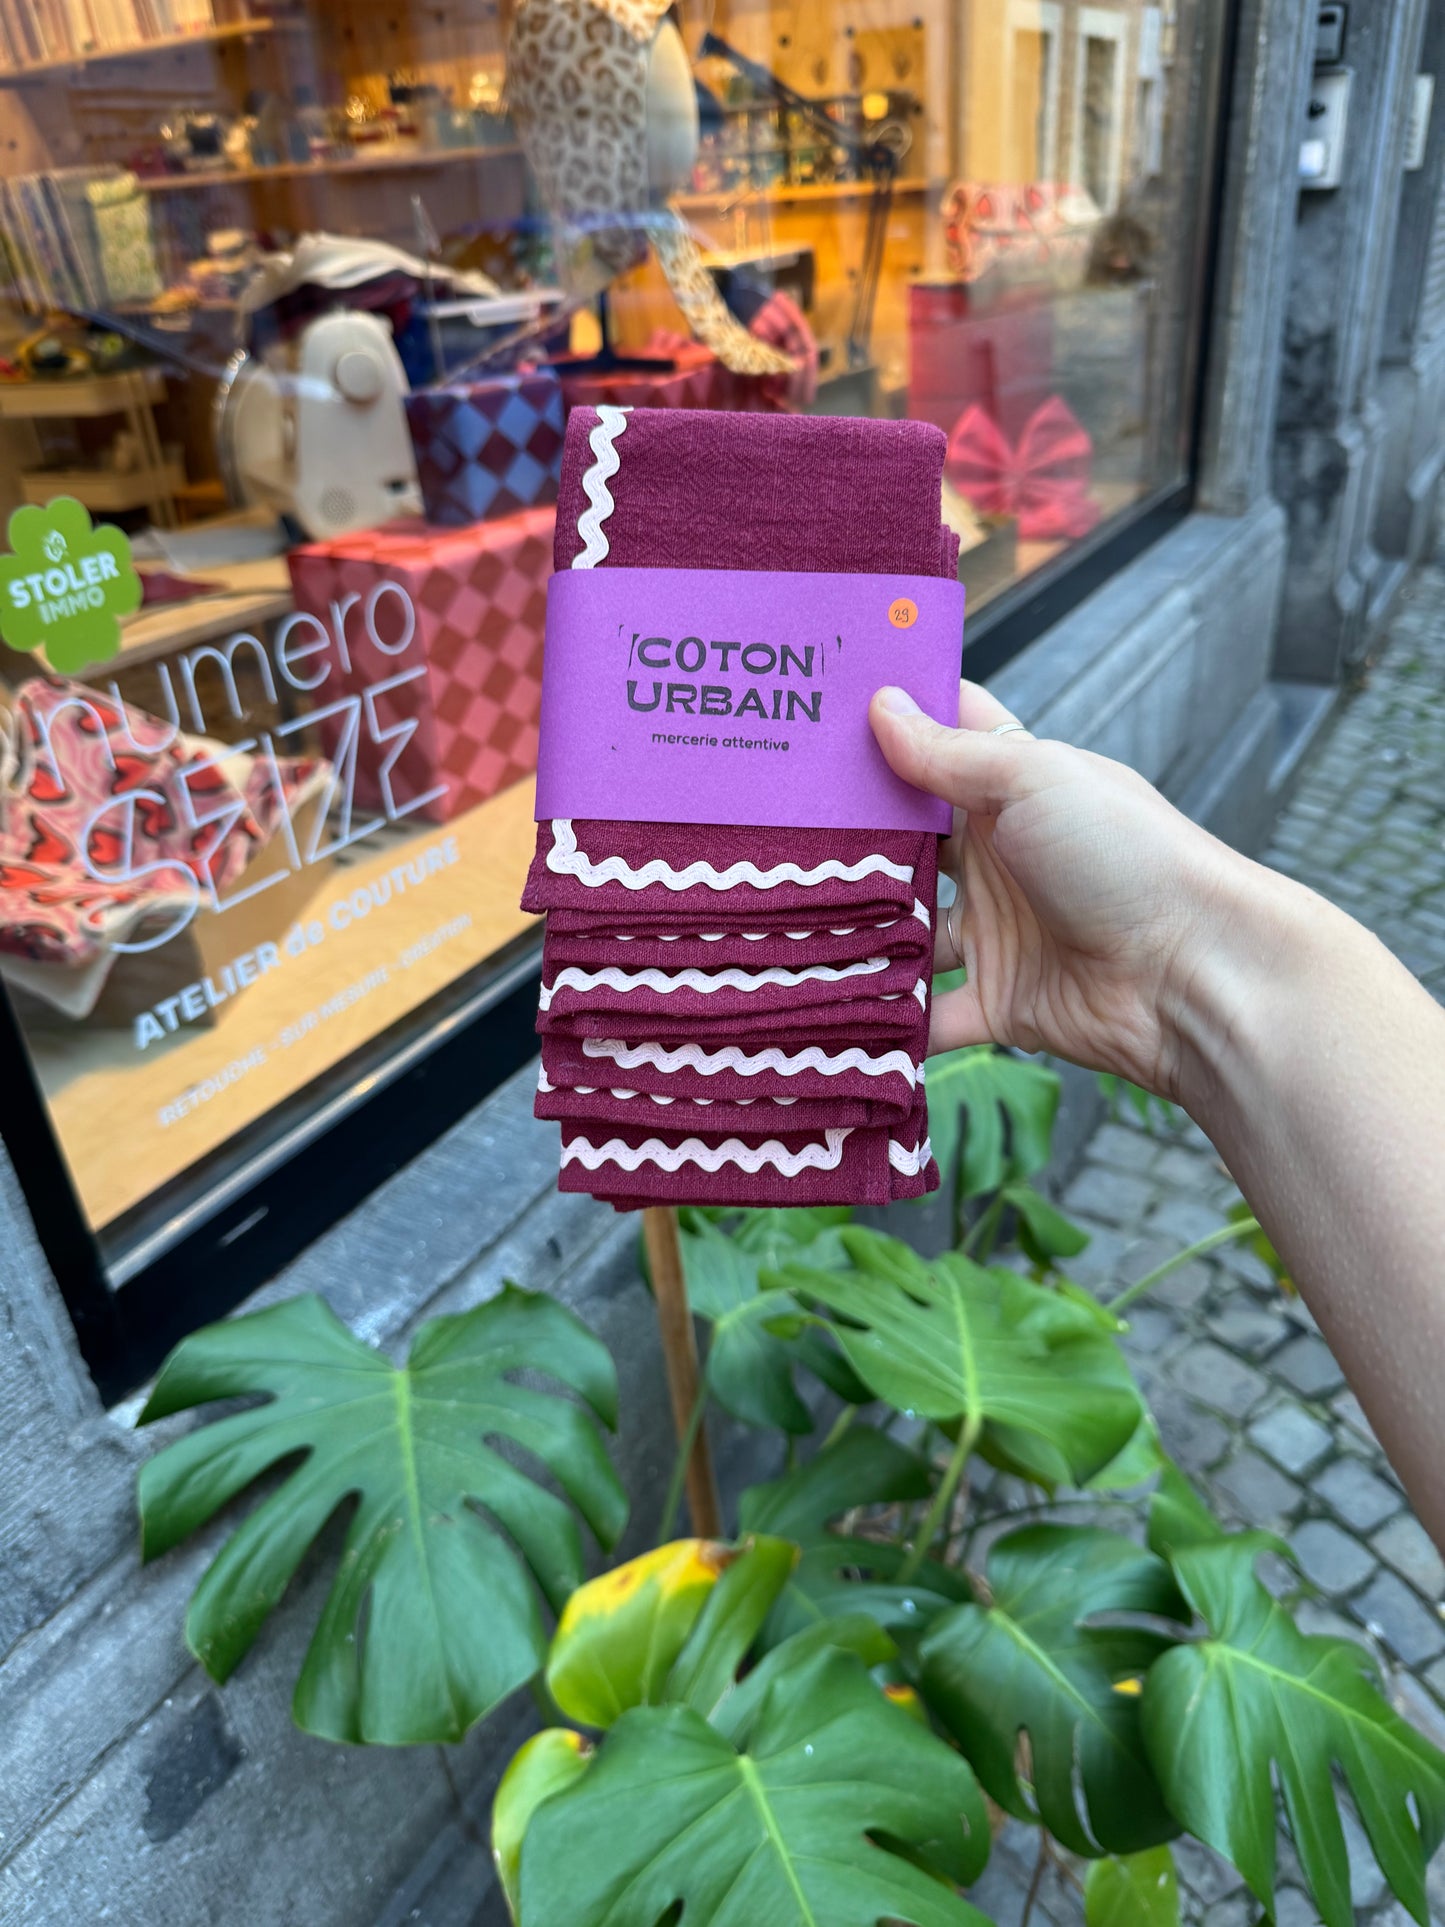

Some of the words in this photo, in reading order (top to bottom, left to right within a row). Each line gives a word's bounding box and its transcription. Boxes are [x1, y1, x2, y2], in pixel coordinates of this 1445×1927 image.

[8, 551, 120, 608] STOLER
[38, 586, 106, 624] IMMO
[36, 580, 416, 791] numero
[627, 680, 822, 722] URBAIN
[652, 733, 718, 747] mercerie
[722, 736, 790, 751] attentive
[81, 666, 449, 952] SEIZE
[133, 941, 281, 1050] ATELIER
[286, 920, 325, 958] de
[329, 836, 460, 930] COUTURE
